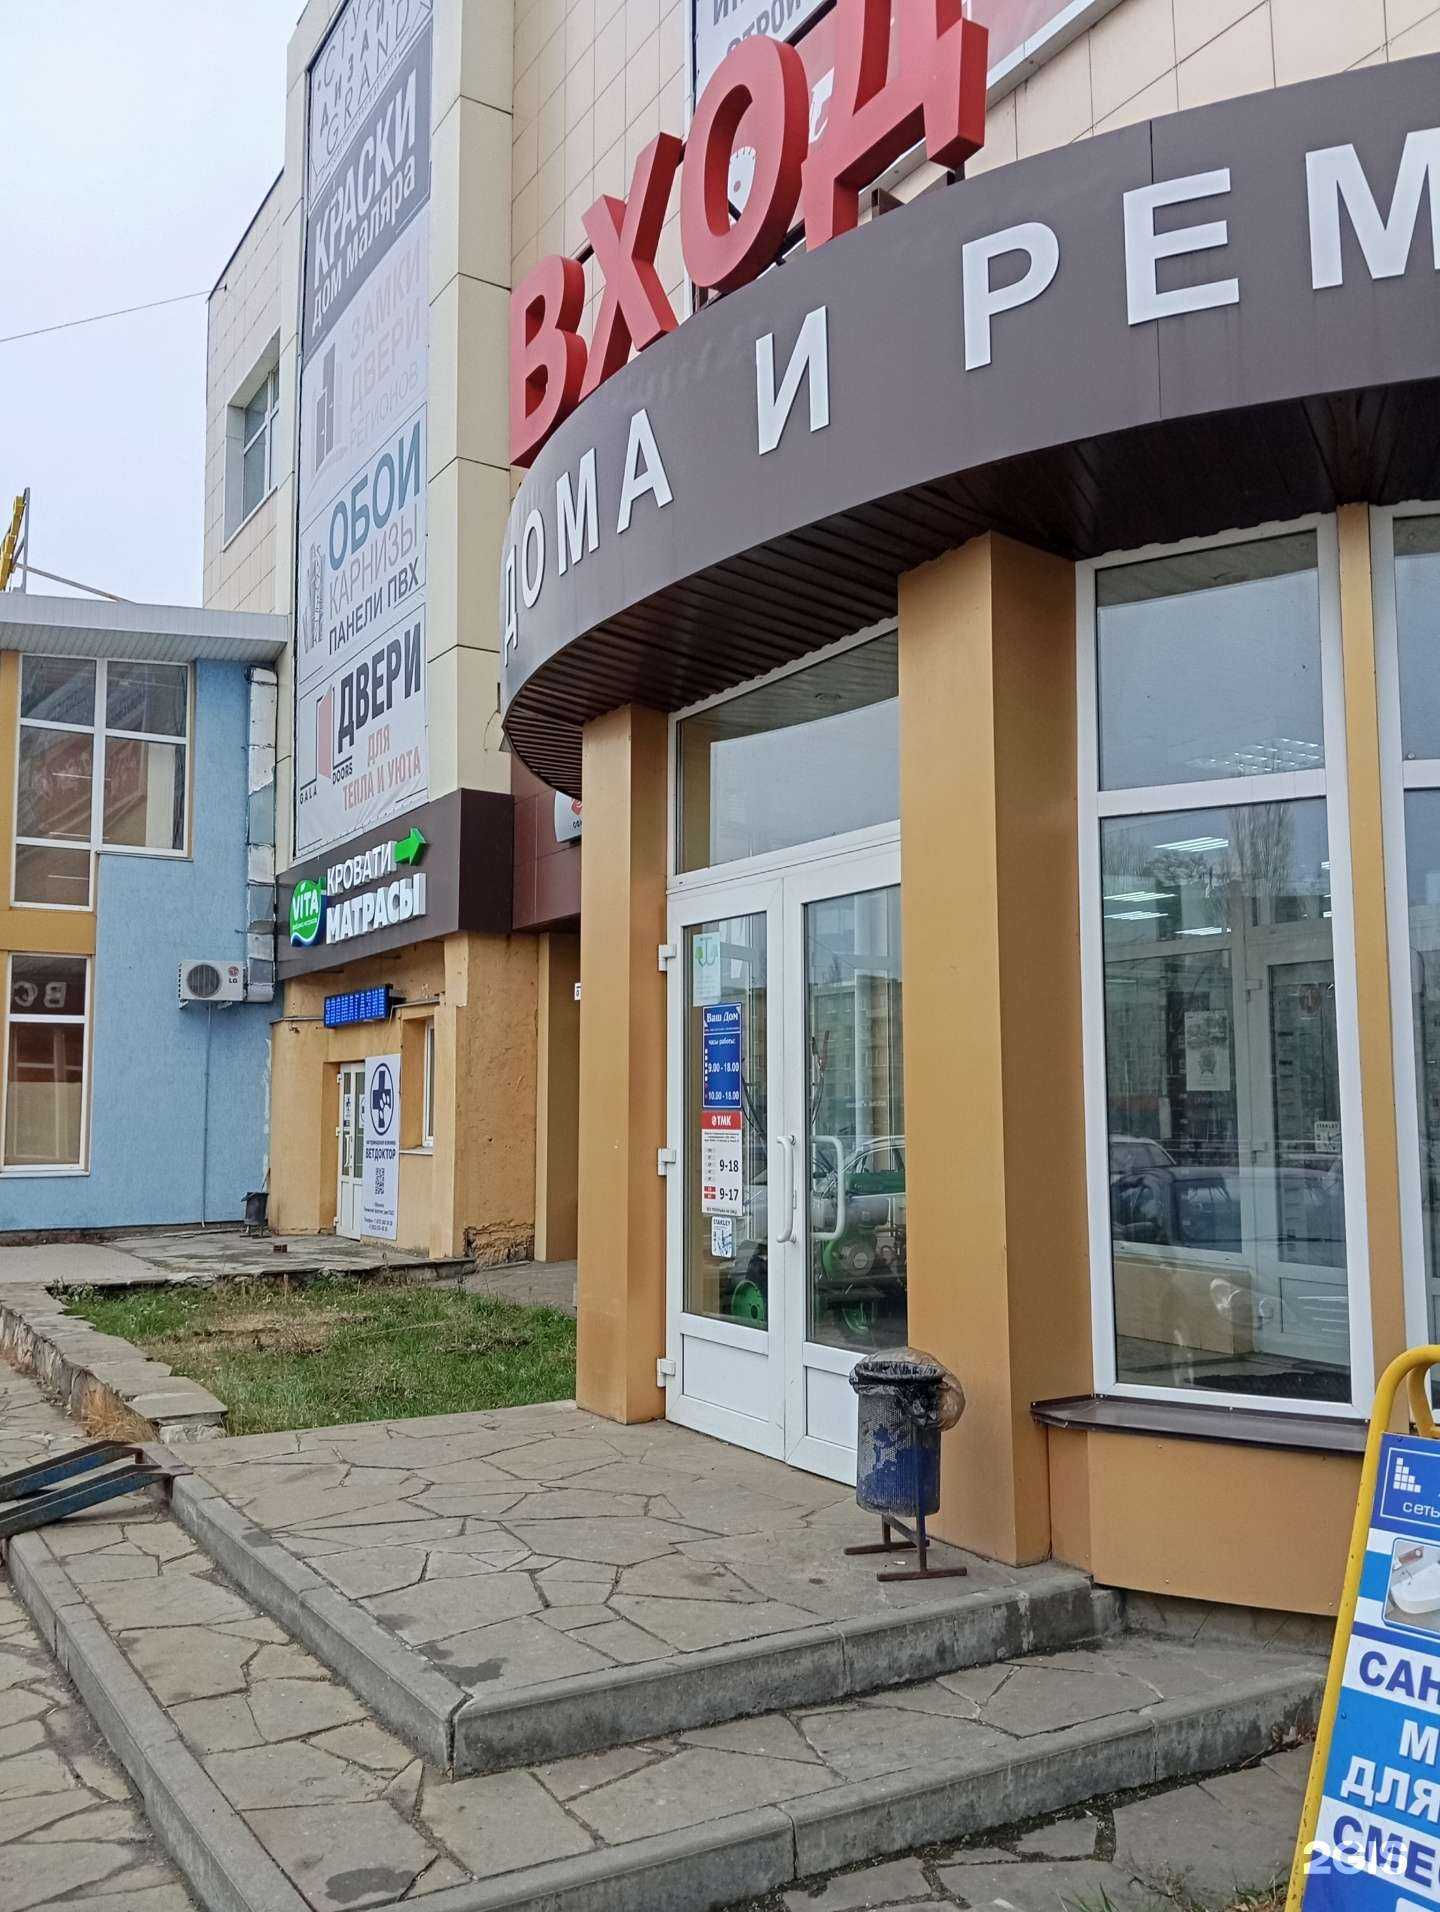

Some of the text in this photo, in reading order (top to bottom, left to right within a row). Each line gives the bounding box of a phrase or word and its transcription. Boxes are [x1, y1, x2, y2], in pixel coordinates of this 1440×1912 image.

[314, 68, 416, 289] КРАСКИ
[510, 0, 988, 468] ВХОД
[351, 238, 420, 358] ЗАМКИ
[350, 297, 420, 422] ДВЕРИ
[504, 126, 1440, 667] ДОМА И РЕМ
[329, 420, 420, 571] ОБОИ
[329, 503, 417, 620] КАРНИЗЫ
[329, 556, 419, 655] ПАНЕЛИ ПВХ
[338, 622, 421, 754] ДВЕРИ
[332, 762, 353, 784] DOORS
[342, 746, 421, 811] ТЕПЛА И УЮТА
[368, 724, 390, 767] ДЛЯ
[327, 840, 397, 896] КРОВАТИ
[326, 872, 426, 944] МАТРАСЫ
[706, 1011, 738, 1023] Ваш Дом
[366, 1147, 396, 1162] ВЕТДОКТОР
[1402, 1501, 1440, 1518] сеть
[1359, 1651, 1440, 1702] САН
[1340, 1755, 1440, 1823] ДЛЯ
[1333, 1815, 1440, 1888] СМЕ
